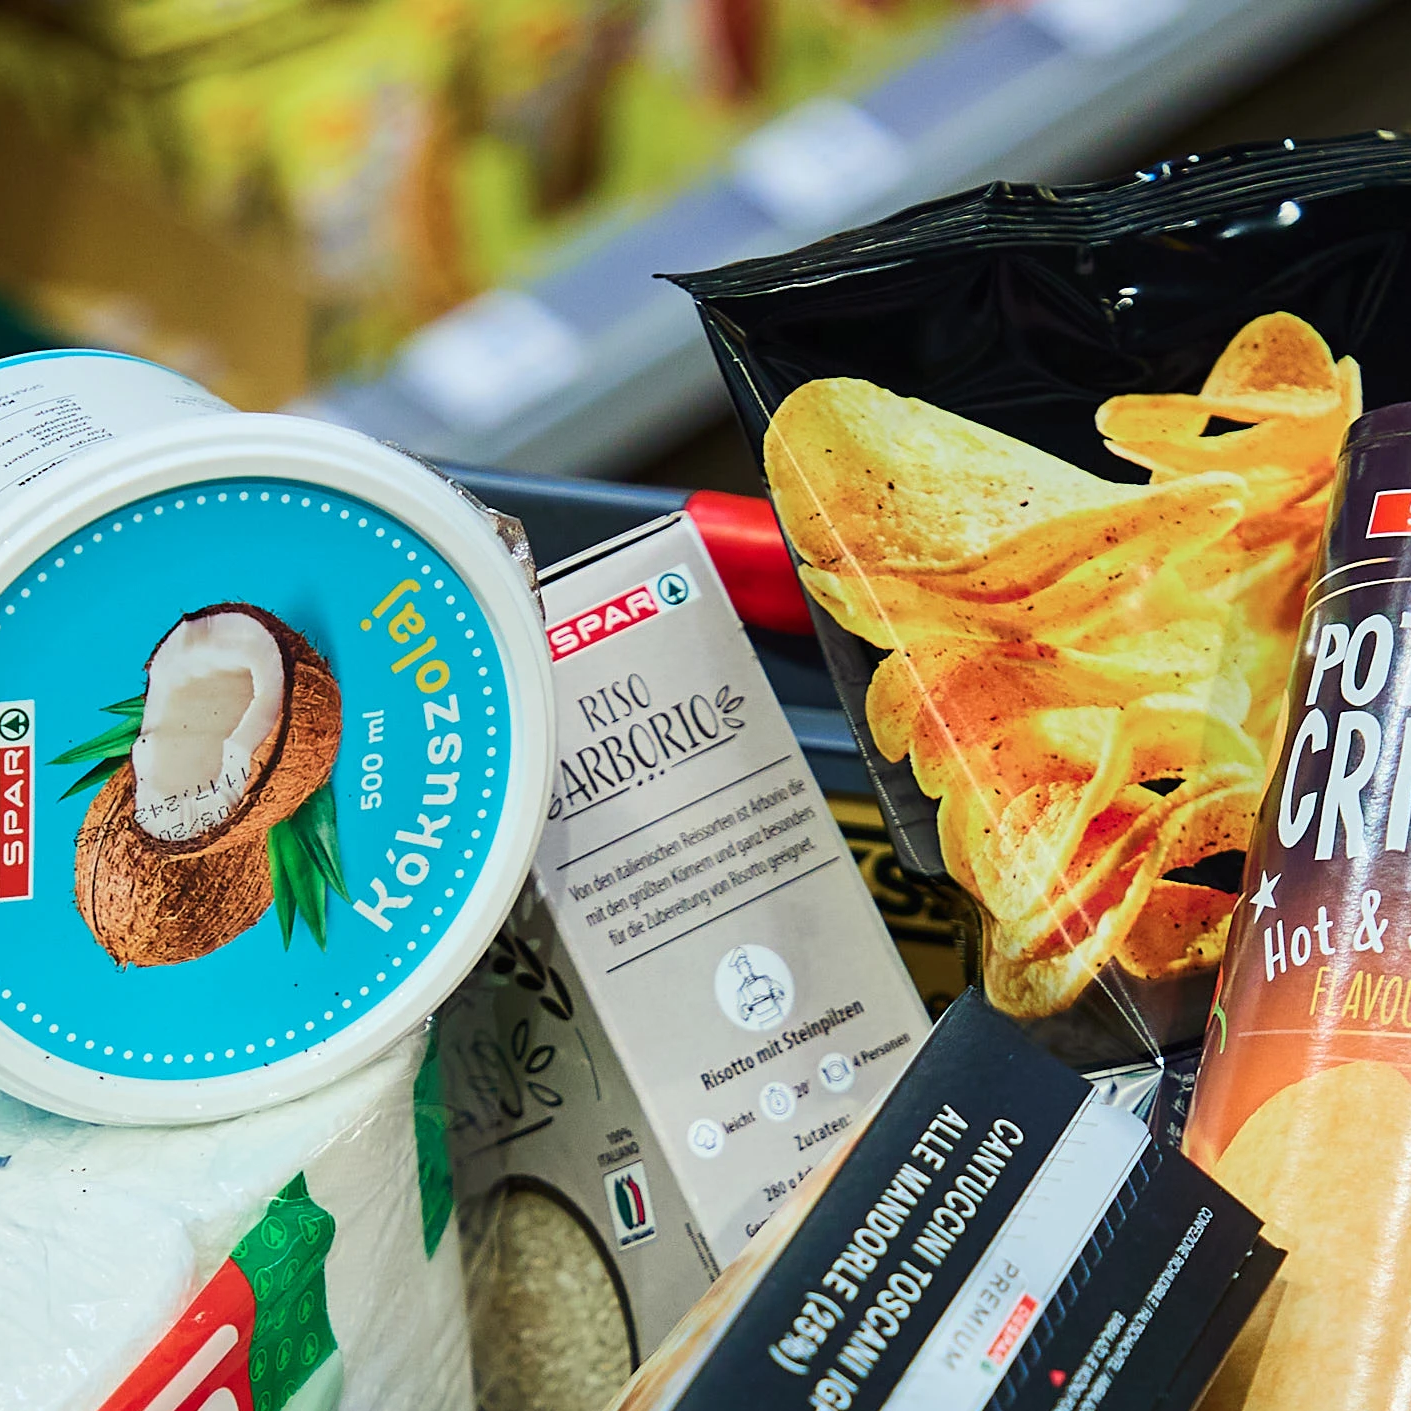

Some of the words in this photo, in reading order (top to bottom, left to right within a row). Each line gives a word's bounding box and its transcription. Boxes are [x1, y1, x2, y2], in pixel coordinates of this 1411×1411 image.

[550, 590, 655, 654] SPAR
[362, 709, 384, 744] ml
[578, 673, 651, 732] RISO
[352, 578, 463, 933] Kókuszolaj
[360, 753, 384, 811] 500
[560, 694, 720, 806] ARBORIO
[3, 749, 25, 867] SPAR
[568, 884, 592, 902] Von
[593, 869, 616, 891] den
[614, 837, 686, 884] italienischen
[680, 812, 736, 850] Reissorten
[735, 803, 750, 823] ist
[748, 786, 788, 816] Arborio
[787, 777, 807, 797] die
[585, 906, 606, 928] mit
[605, 896, 629, 919] den
[628, 876, 672, 911] größten
[714, 842, 736, 867] und
[736, 831, 762, 859] ganz
[761, 804, 817, 840] besonders
[608, 927, 626, 947] für
[626, 916, 645, 938] die
[644, 888, 712, 929] Zubereitung
[710, 877, 731, 898] von
[729, 857, 768, 890] Risotto
[768, 835, 817, 870] geeignet.
[1263, 905, 1337, 982] Hot
[1352, 889, 1389, 954] &
[700, 1050, 754, 1092] Risotto
[755, 1036, 783, 1064] mit
[779, 998, 866, 1053] Steinpilzen
[853, 1052, 863, 1069] 4
[861, 1031, 912, 1064] Personen
[722, 1111, 757, 1135] leicht
[793, 1113, 852, 1151] Zutaten:
[912, 1104, 970, 1170] ALLE
[763, 1180, 787, 1202] 280
[822, 1163, 933, 1302] MANDORLE
[912, 1118, 1025, 1267] CANTUCCINI
[1175, 1204, 1215, 1259] CONFEZIONE
[768, 1291, 846, 1376] (25%)
[839, 1260, 933, 1379] TOSCANI
[942, 1258, 1020, 1371] PREMIUM
